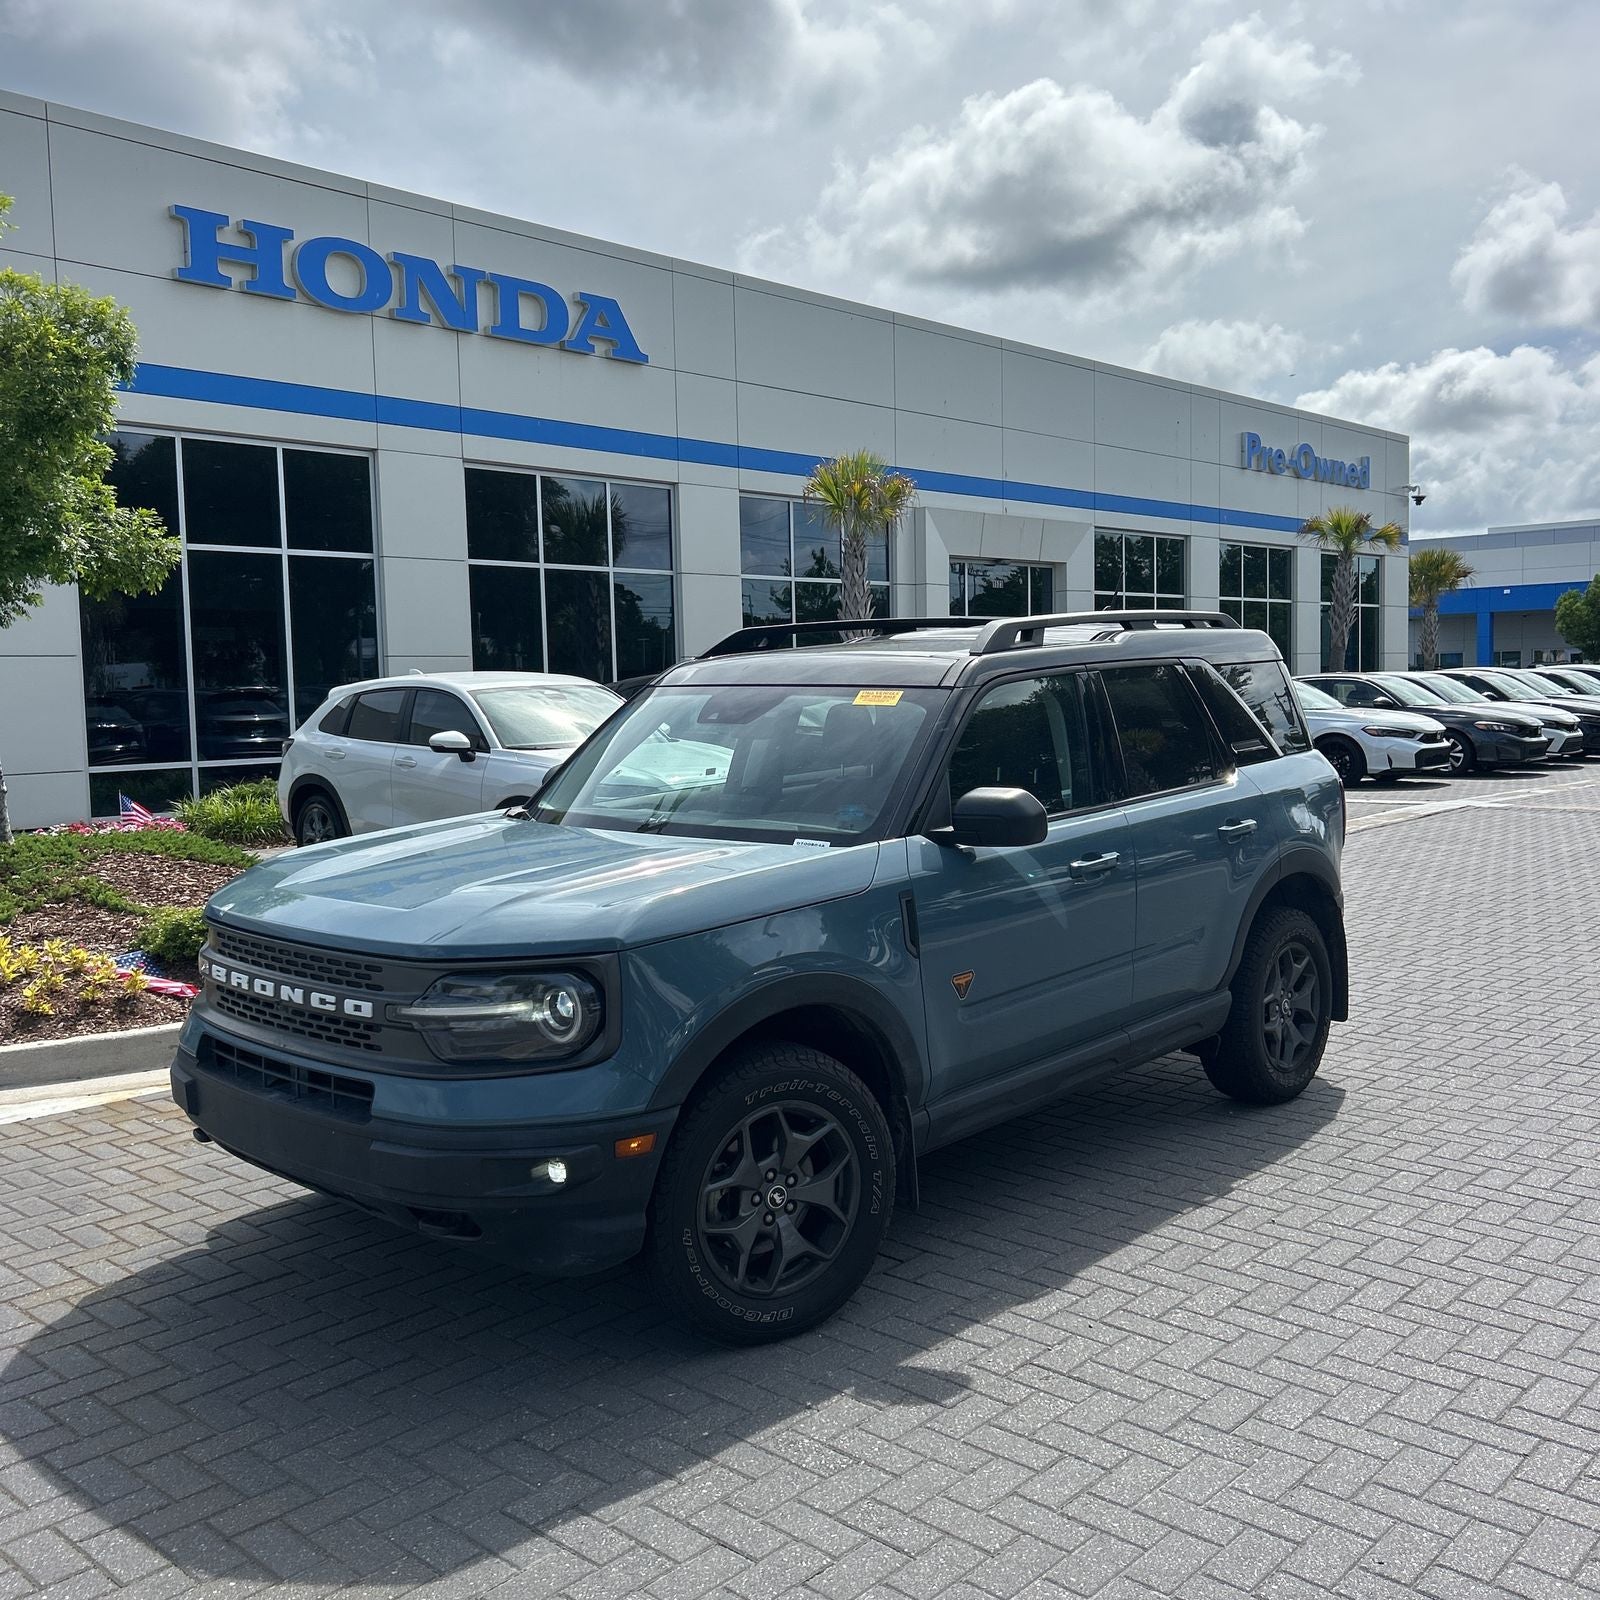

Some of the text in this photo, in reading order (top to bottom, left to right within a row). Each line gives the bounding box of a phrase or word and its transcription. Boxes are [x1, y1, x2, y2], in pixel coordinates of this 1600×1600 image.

[169, 204, 649, 363] HONDA
[1240, 431, 1370, 489] Pre-Owned
[211, 964, 373, 1018] BRONCO
[744, 1079, 883, 1215] Trail-Terrain T/A
[682, 1228, 794, 1323] BFGoodrich
